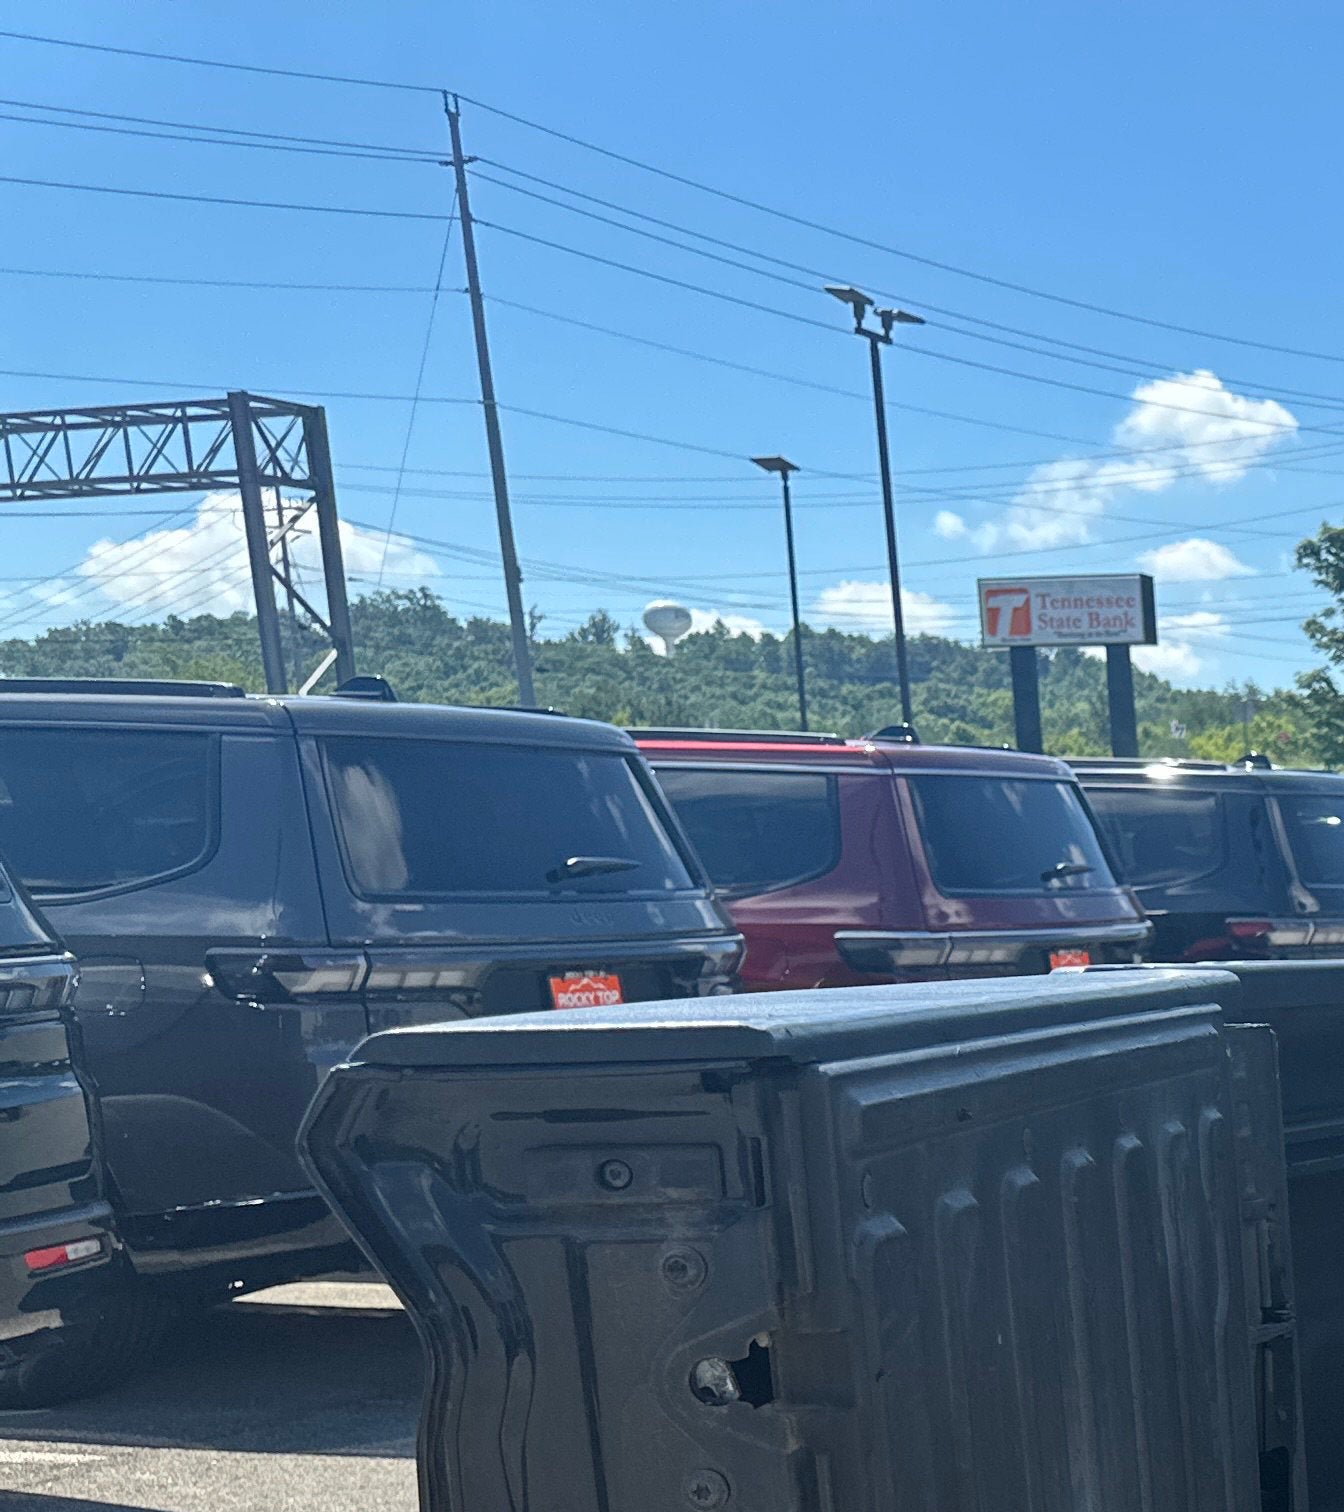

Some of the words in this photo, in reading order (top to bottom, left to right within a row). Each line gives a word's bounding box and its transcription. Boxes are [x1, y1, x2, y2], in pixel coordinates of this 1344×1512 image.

[1035, 592, 1136, 610] Tennessee
[1037, 612, 1083, 630] State
[1087, 611, 1137, 630] Bank
[597, 989, 620, 1005] TOP
